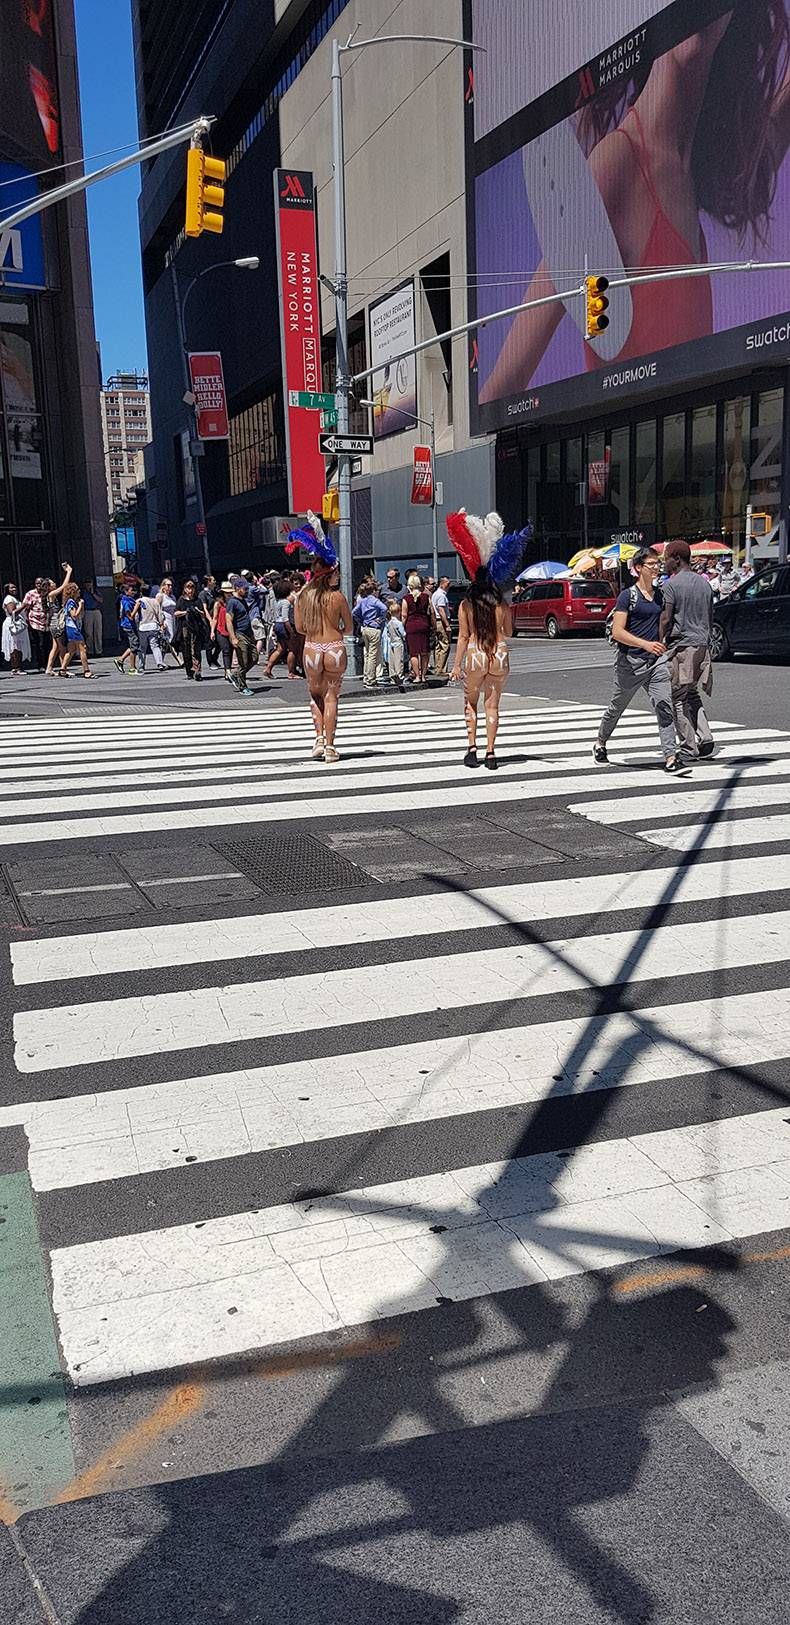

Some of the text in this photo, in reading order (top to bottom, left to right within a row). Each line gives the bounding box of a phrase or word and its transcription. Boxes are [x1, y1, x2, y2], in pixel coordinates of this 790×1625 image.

[600, 29, 647, 71] MARRIOTT
[600, 50, 641, 87] MARQUIS
[287, 251, 299, 332] NEW YORK
[300, 252, 317, 394] MARRIOTT MARQU
[602, 362, 657, 389] #YOURMOVE
[309, 394, 315, 406] 7
[507, 397, 534, 416] swatch
[327, 440, 367, 449] ONE WAY
[610, 531, 639, 544] swatch
